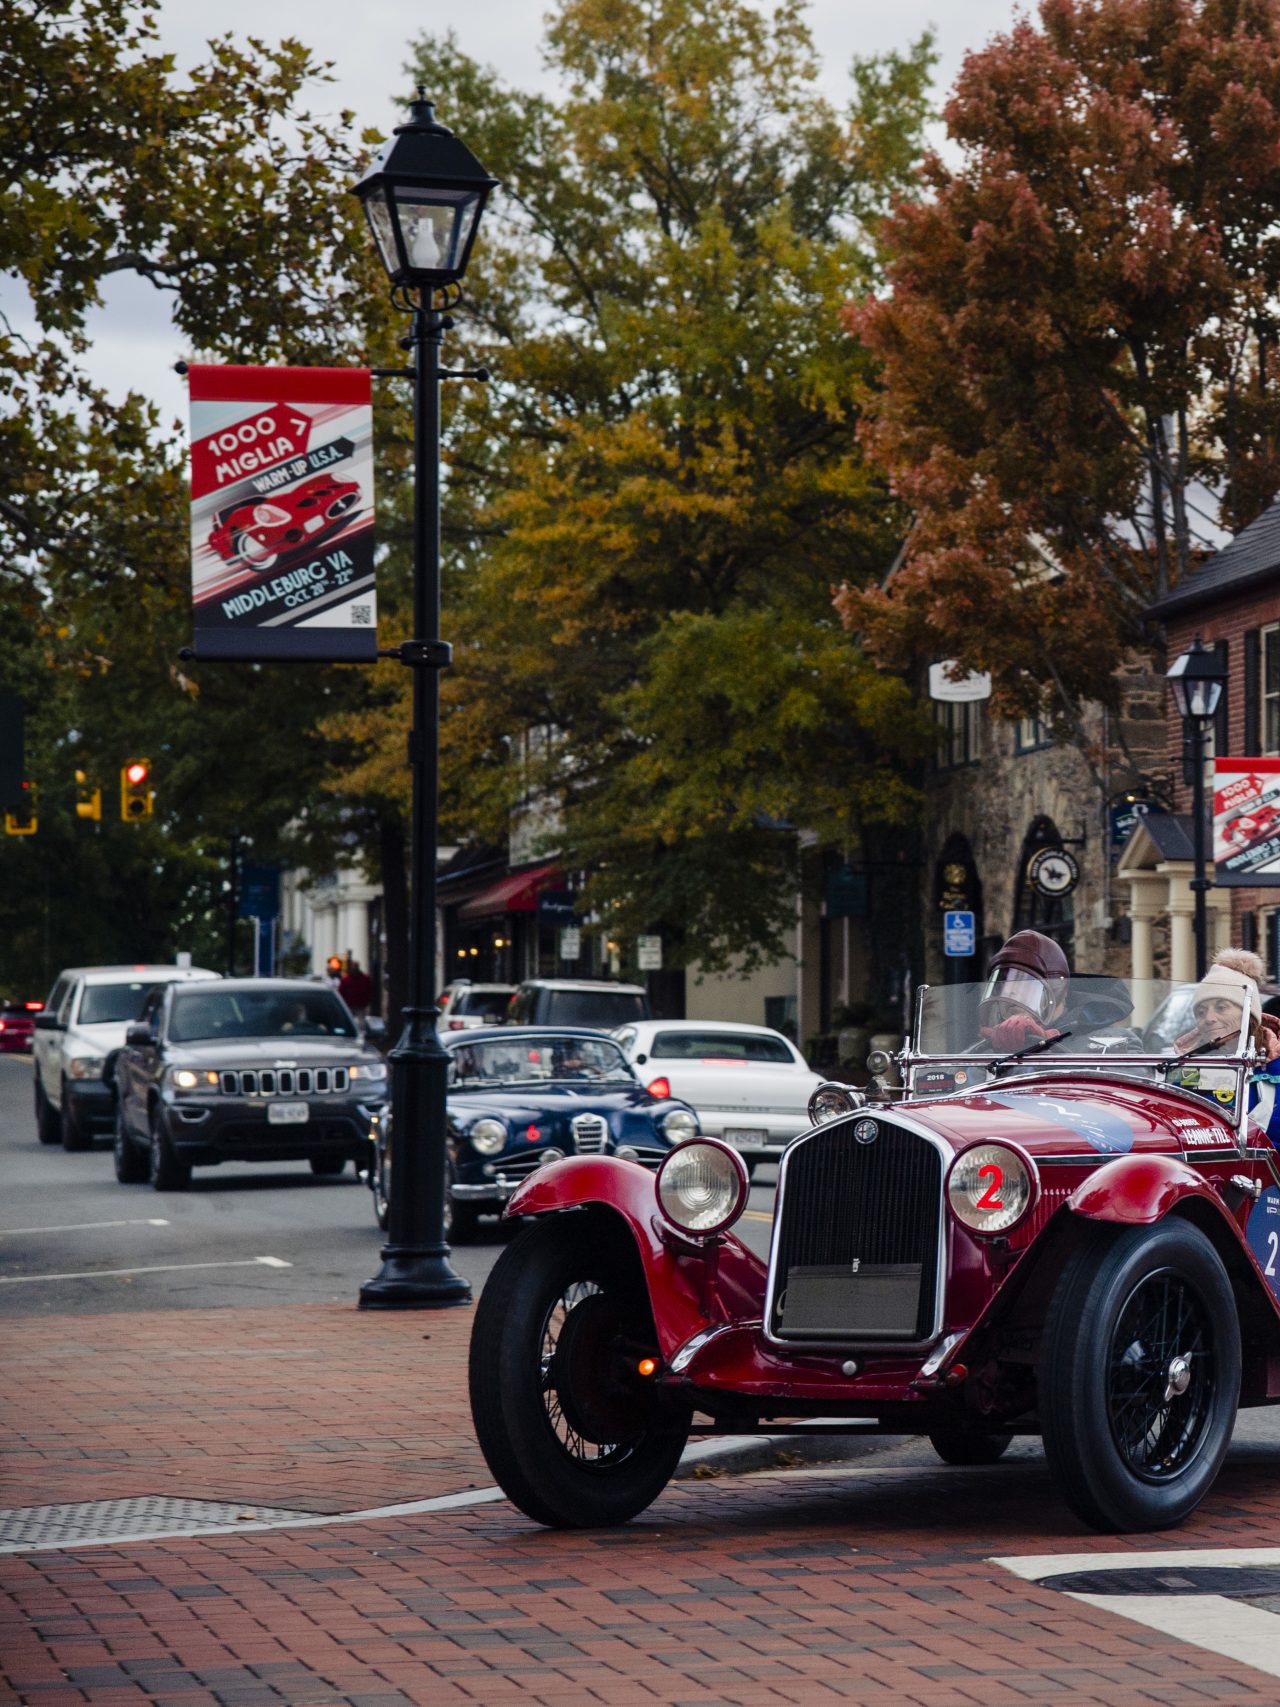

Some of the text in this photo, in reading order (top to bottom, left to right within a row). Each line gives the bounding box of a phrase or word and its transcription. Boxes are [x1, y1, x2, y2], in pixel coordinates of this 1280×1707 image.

[208, 416, 276, 456] 1000
[216, 436, 294, 483] MIGLIA
[252, 445, 344, 494] WARM-UP U.S.A.
[222, 550, 353, 619] MIDDLEBURG VA
[1221, 779, 1250, 797] 1000
[525, 1124, 541, 1142] 6
[1182, 1127, 1231, 1145] LEANNE TILL
[976, 1164, 1003, 1209] 2
[1264, 1231, 1279, 1277] 2
